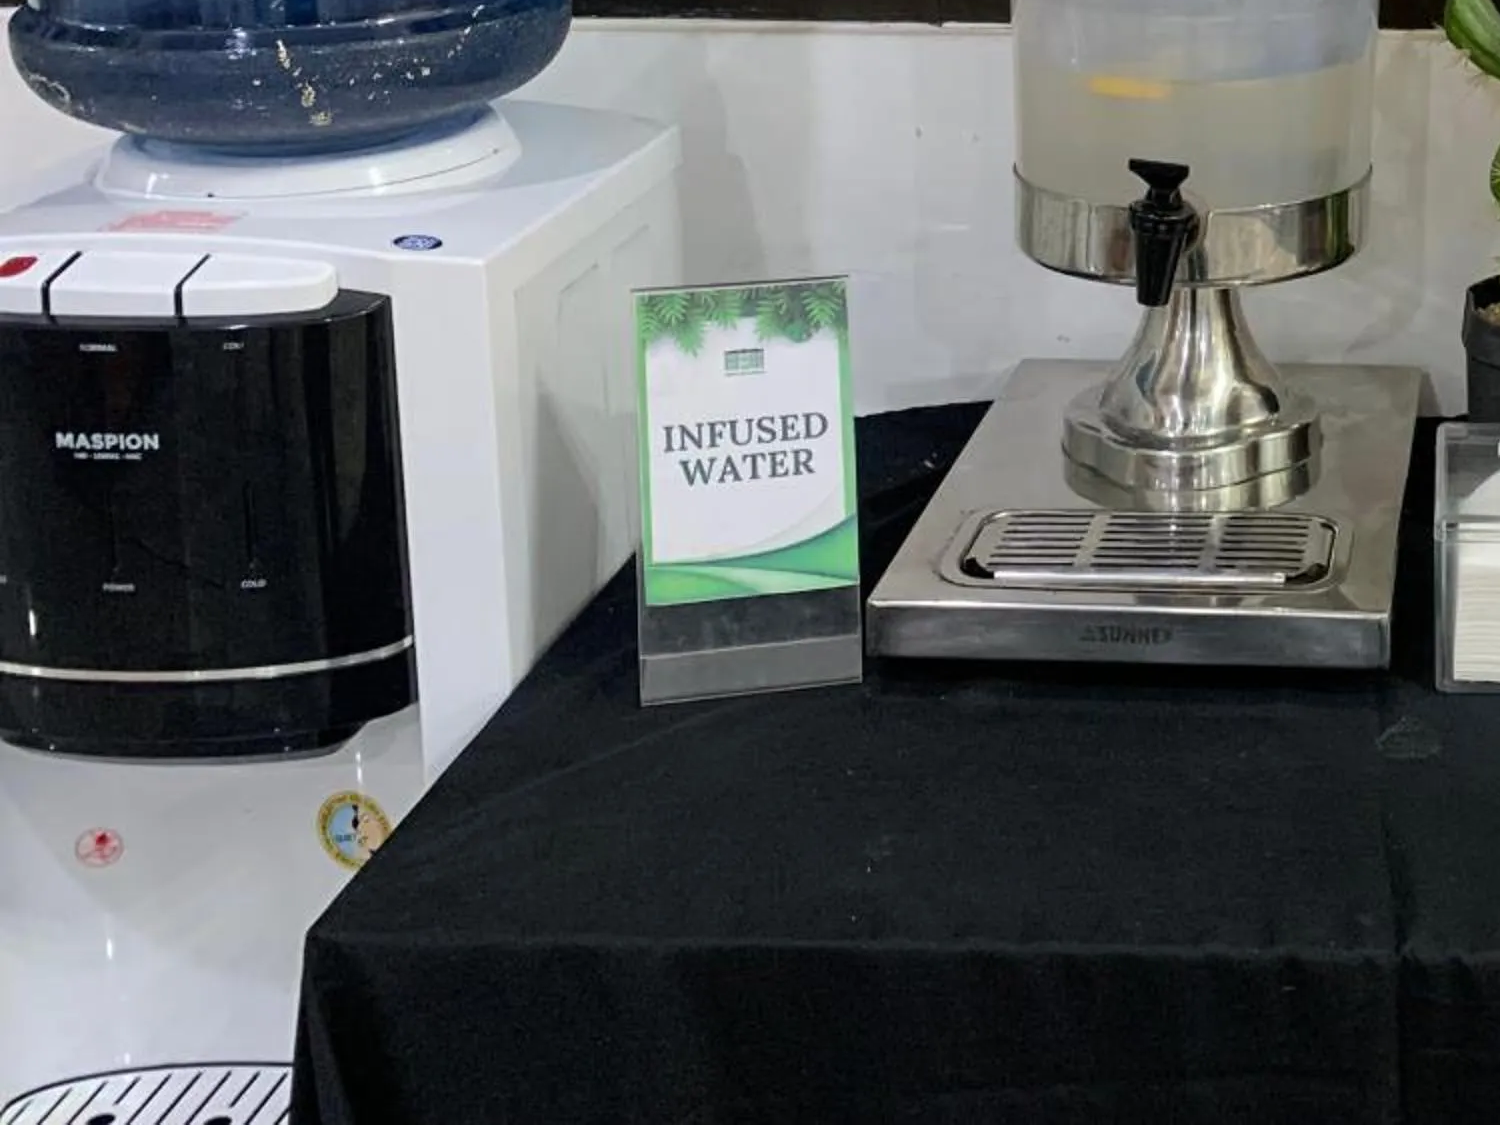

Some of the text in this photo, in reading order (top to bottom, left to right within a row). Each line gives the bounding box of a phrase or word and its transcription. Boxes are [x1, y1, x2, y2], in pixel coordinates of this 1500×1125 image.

[56, 432, 160, 450] MASPION
[663, 412, 828, 452] INFUSED
[680, 449, 815, 486] WATER
